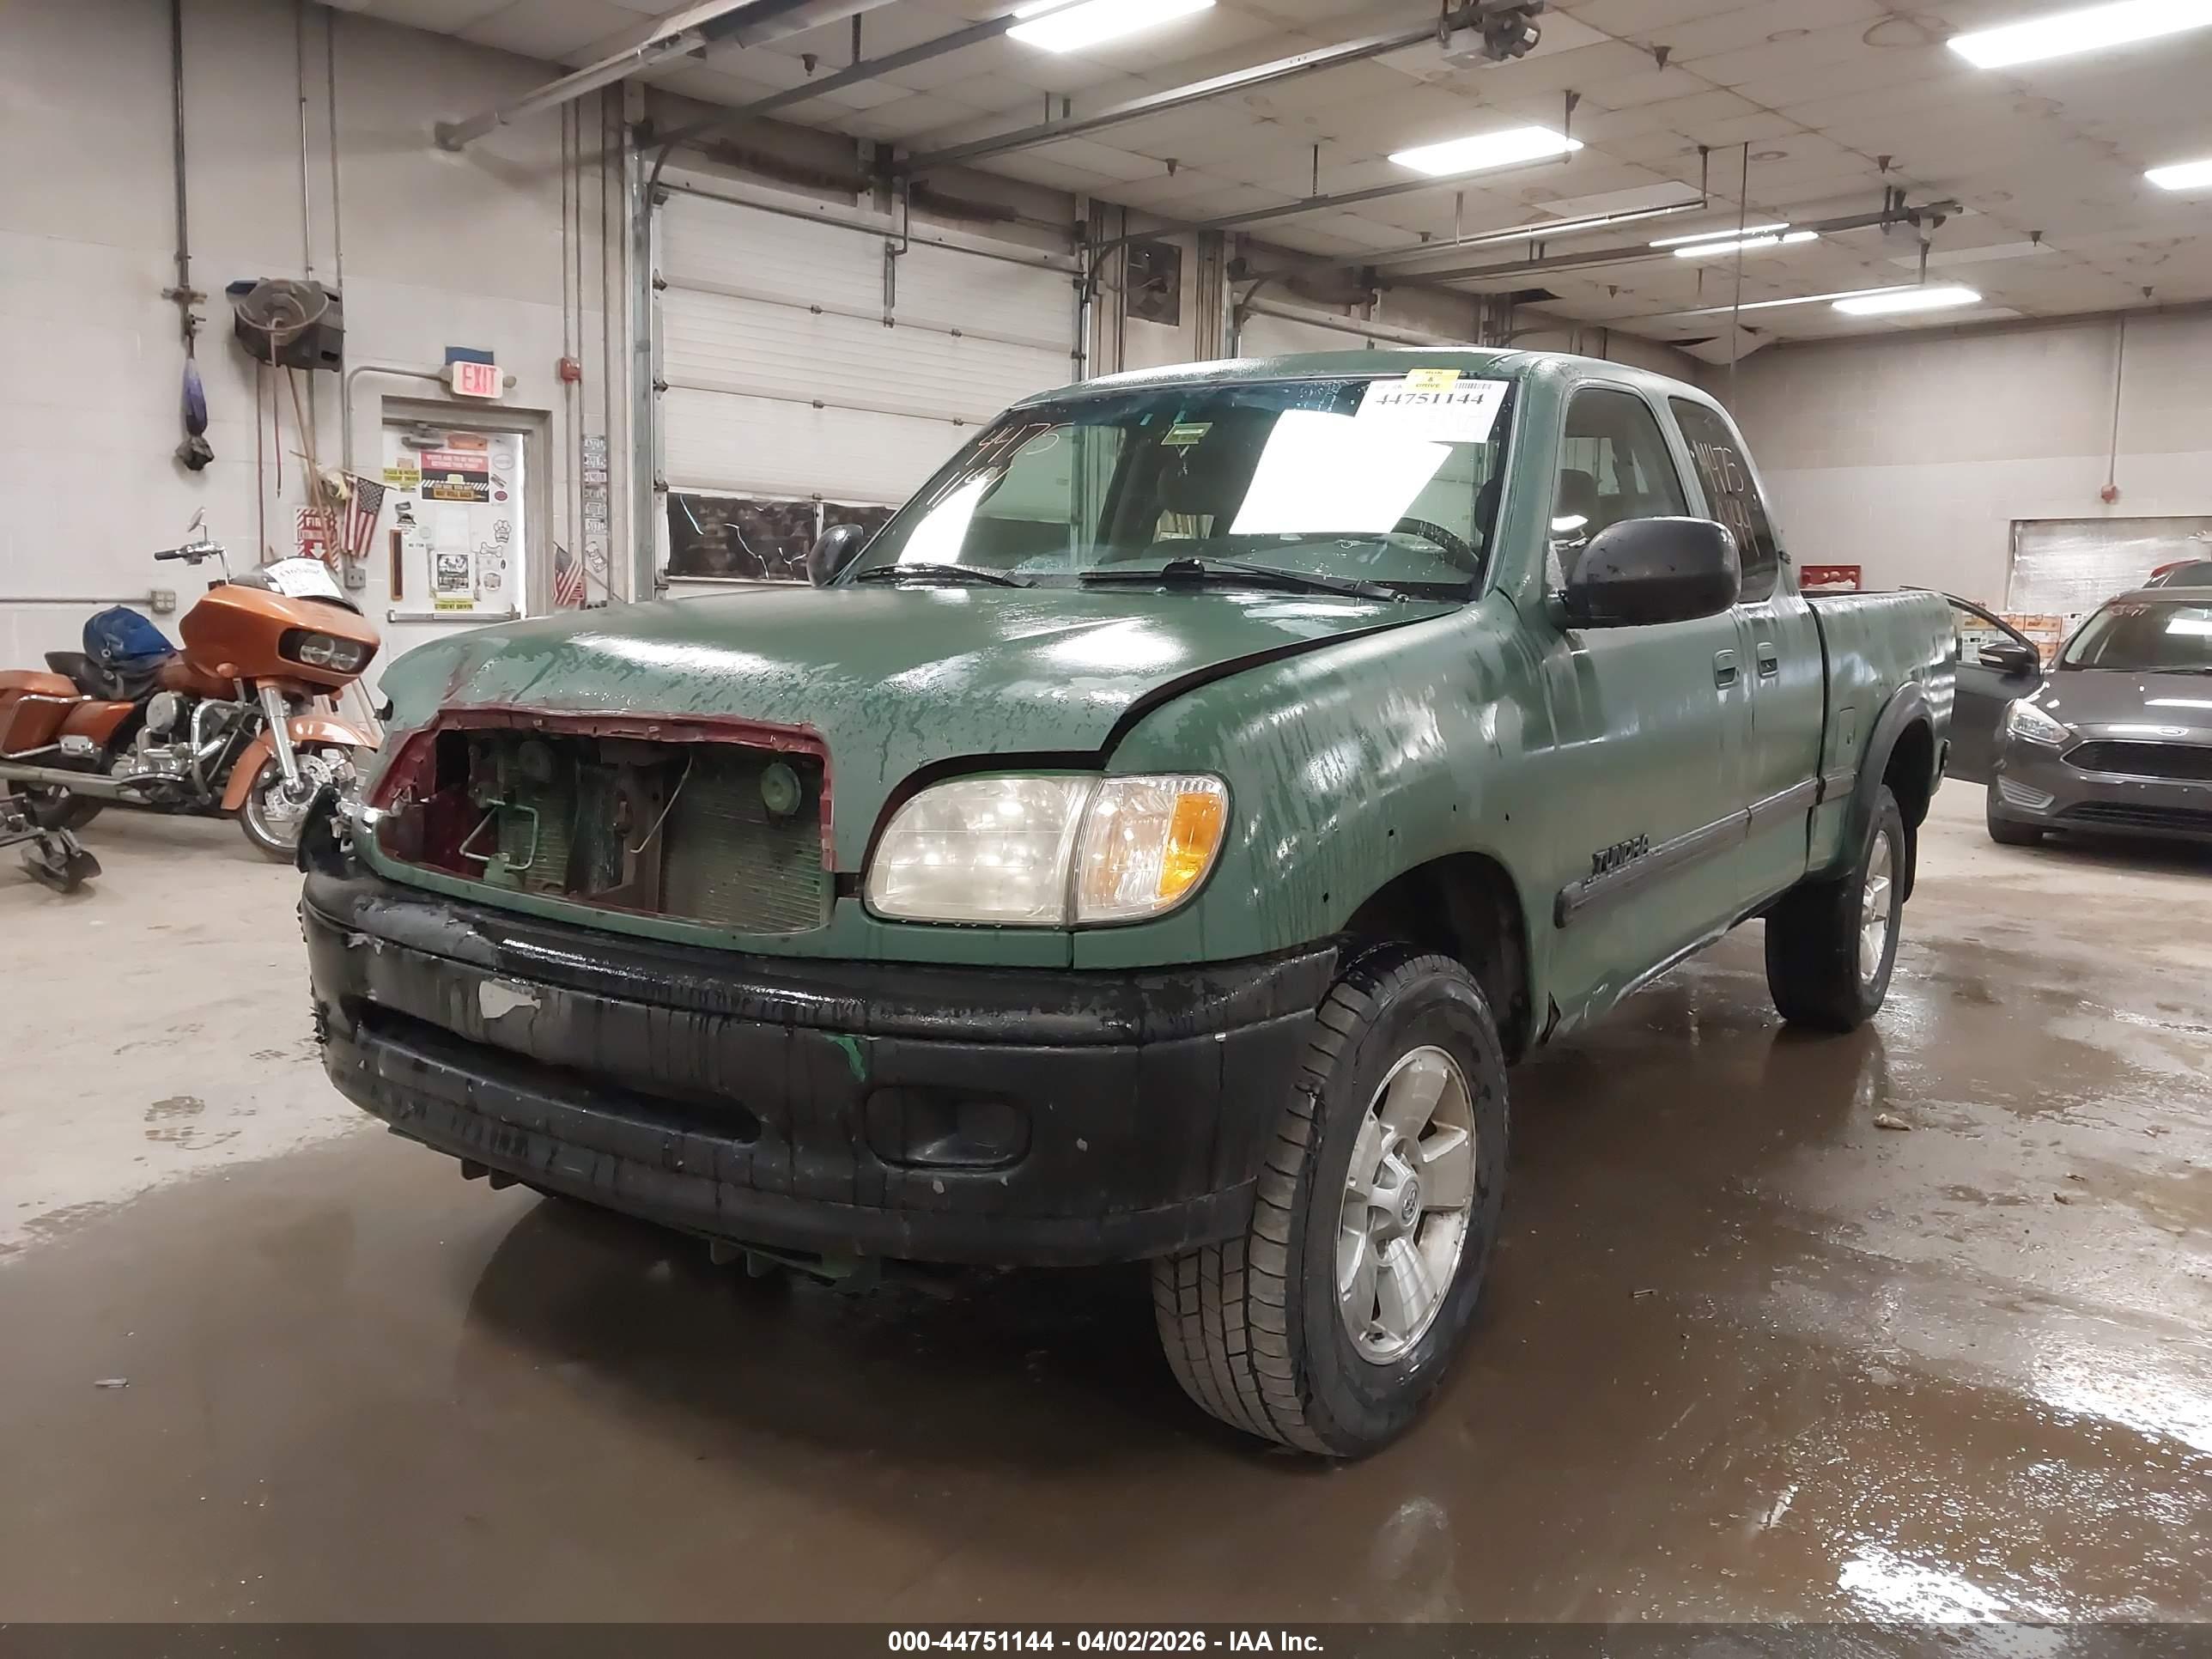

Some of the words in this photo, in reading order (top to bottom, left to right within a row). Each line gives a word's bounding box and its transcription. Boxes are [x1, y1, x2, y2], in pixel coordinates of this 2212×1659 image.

[463, 364, 496, 395] EXIT
[1376, 393, 1485, 404] 44751144
[965, 421, 1075, 465] 4475
[306, 517, 327, 527] FIR
[1592, 833, 1650, 876] TUNDRA
